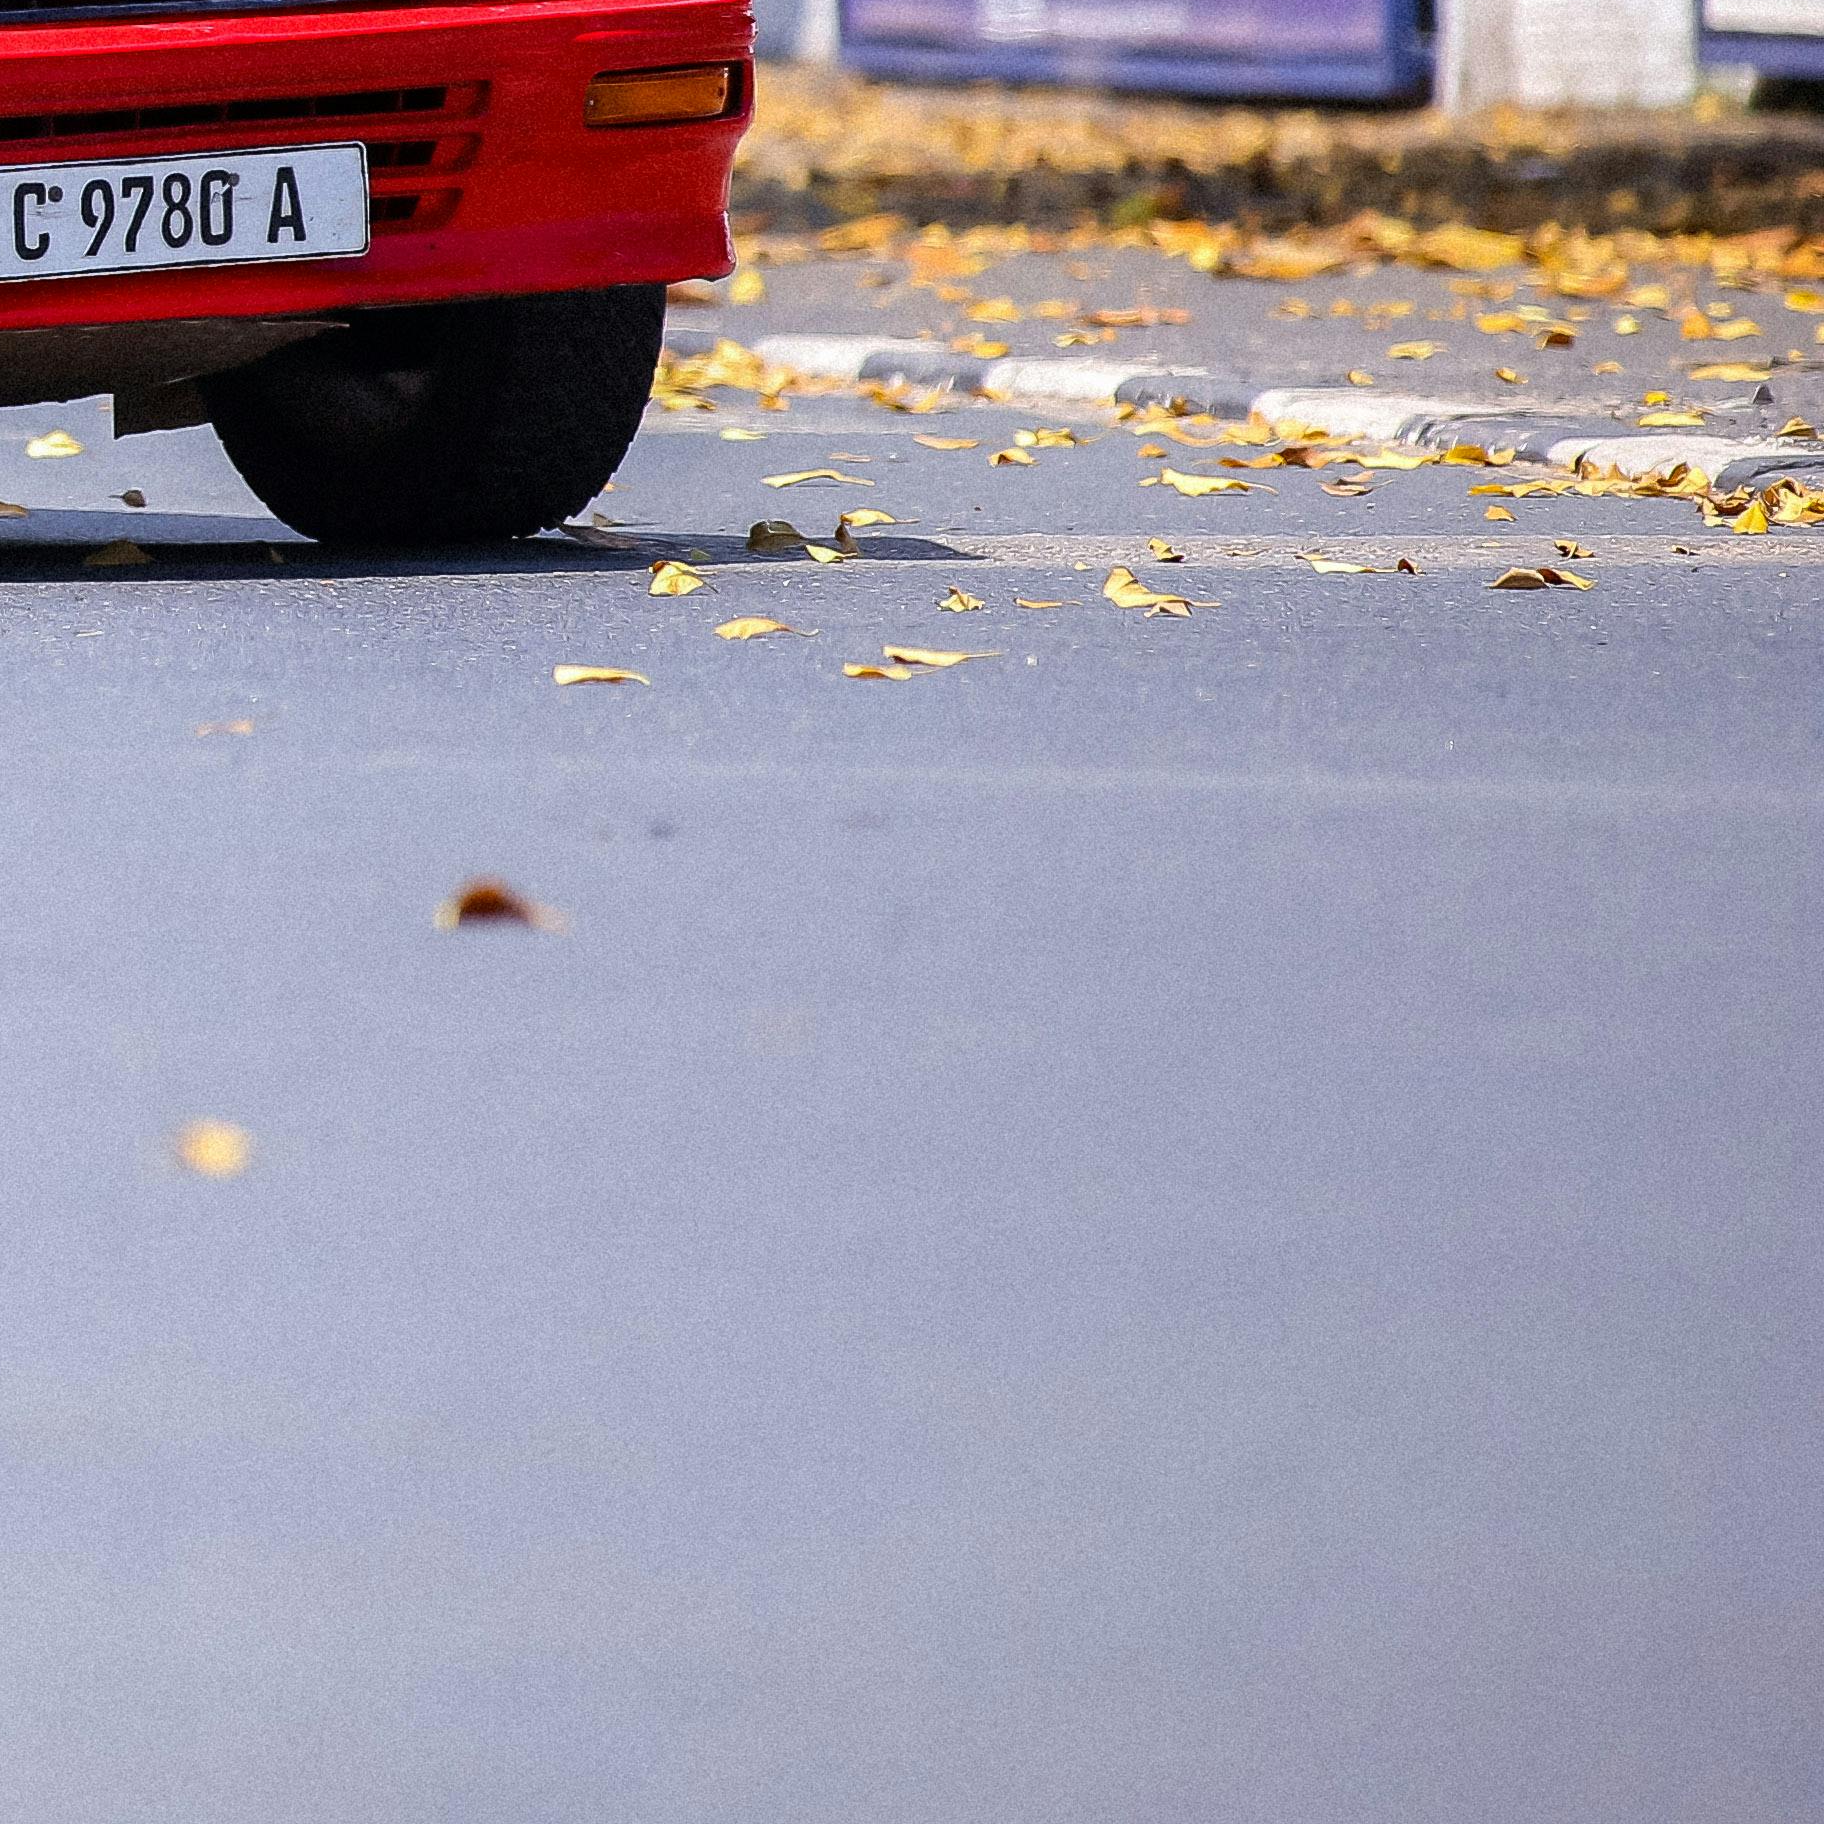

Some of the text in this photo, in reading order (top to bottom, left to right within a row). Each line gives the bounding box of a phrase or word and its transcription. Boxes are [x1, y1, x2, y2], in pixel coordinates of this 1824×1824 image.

[13, 167, 307, 261] C 9780 A
